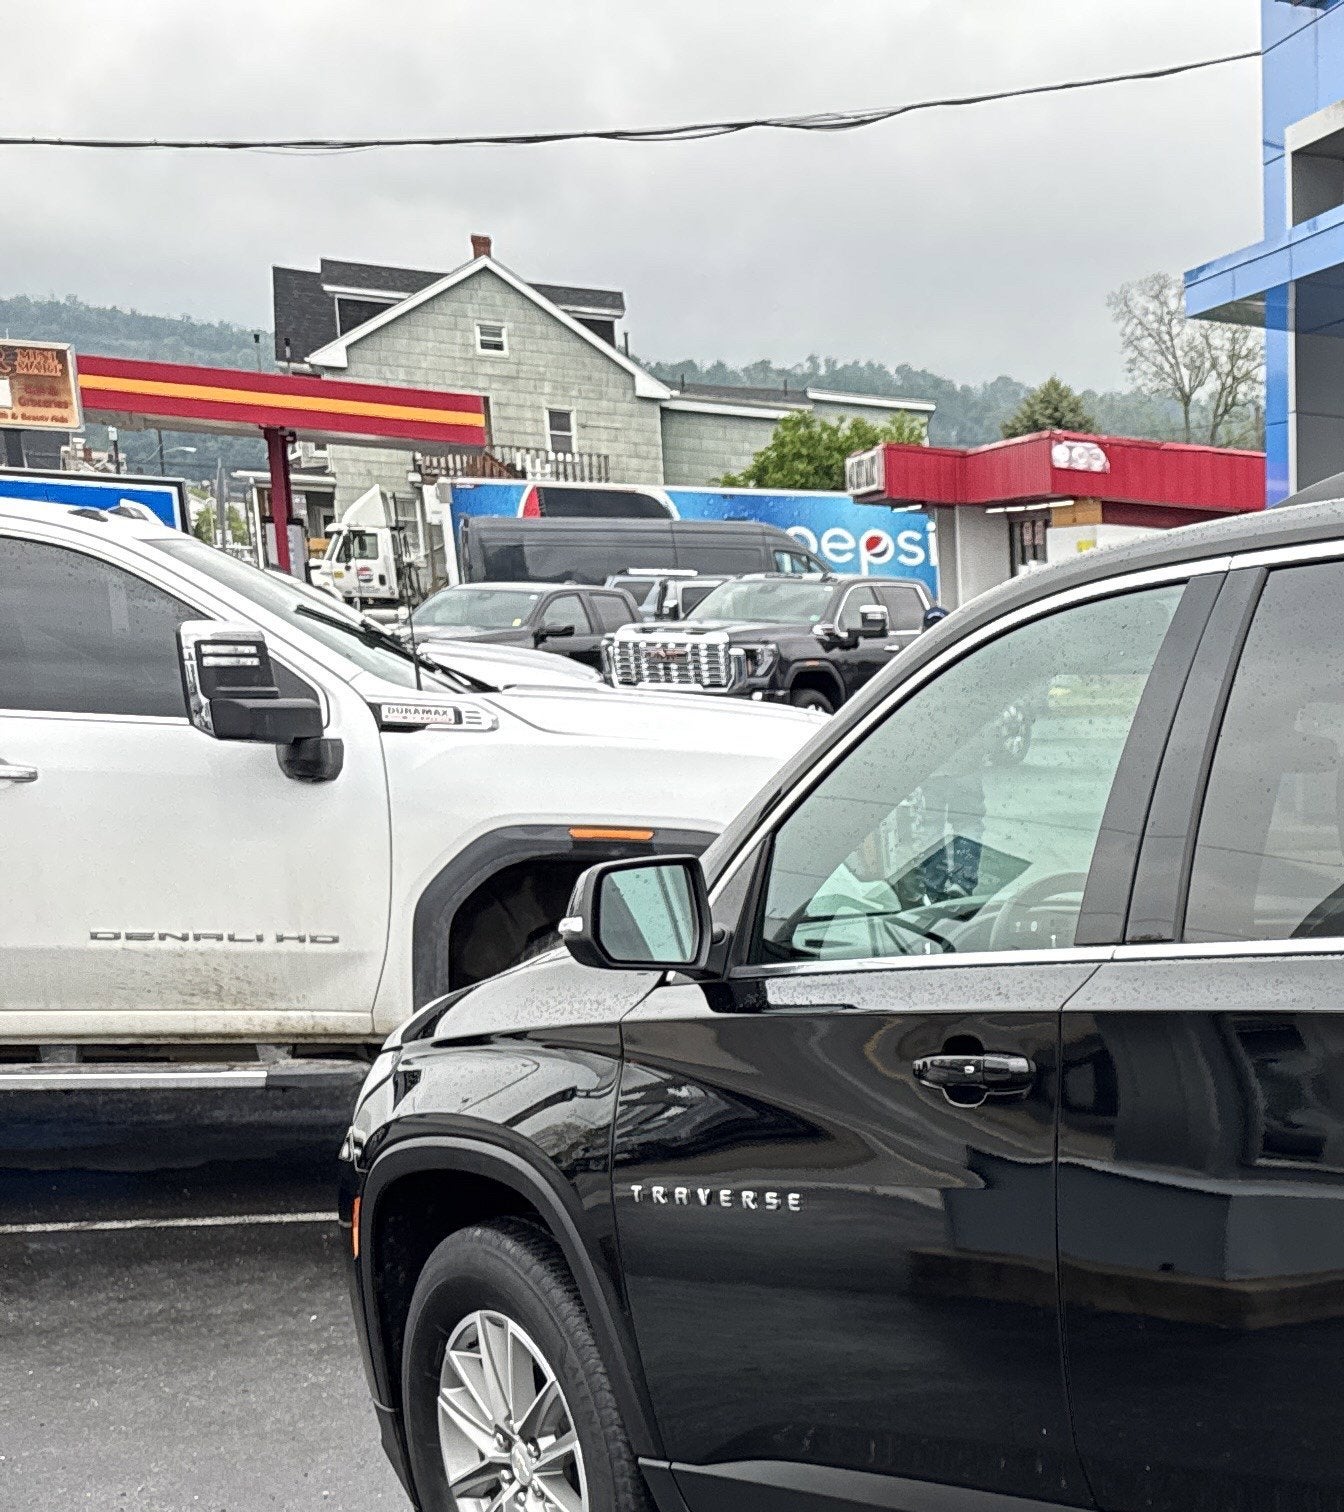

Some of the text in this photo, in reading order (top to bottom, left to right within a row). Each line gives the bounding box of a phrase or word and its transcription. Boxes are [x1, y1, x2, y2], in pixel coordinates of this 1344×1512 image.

[89, 931, 340, 944] DENALI HD
[630, 1185, 802, 1212] TRAVERSE
